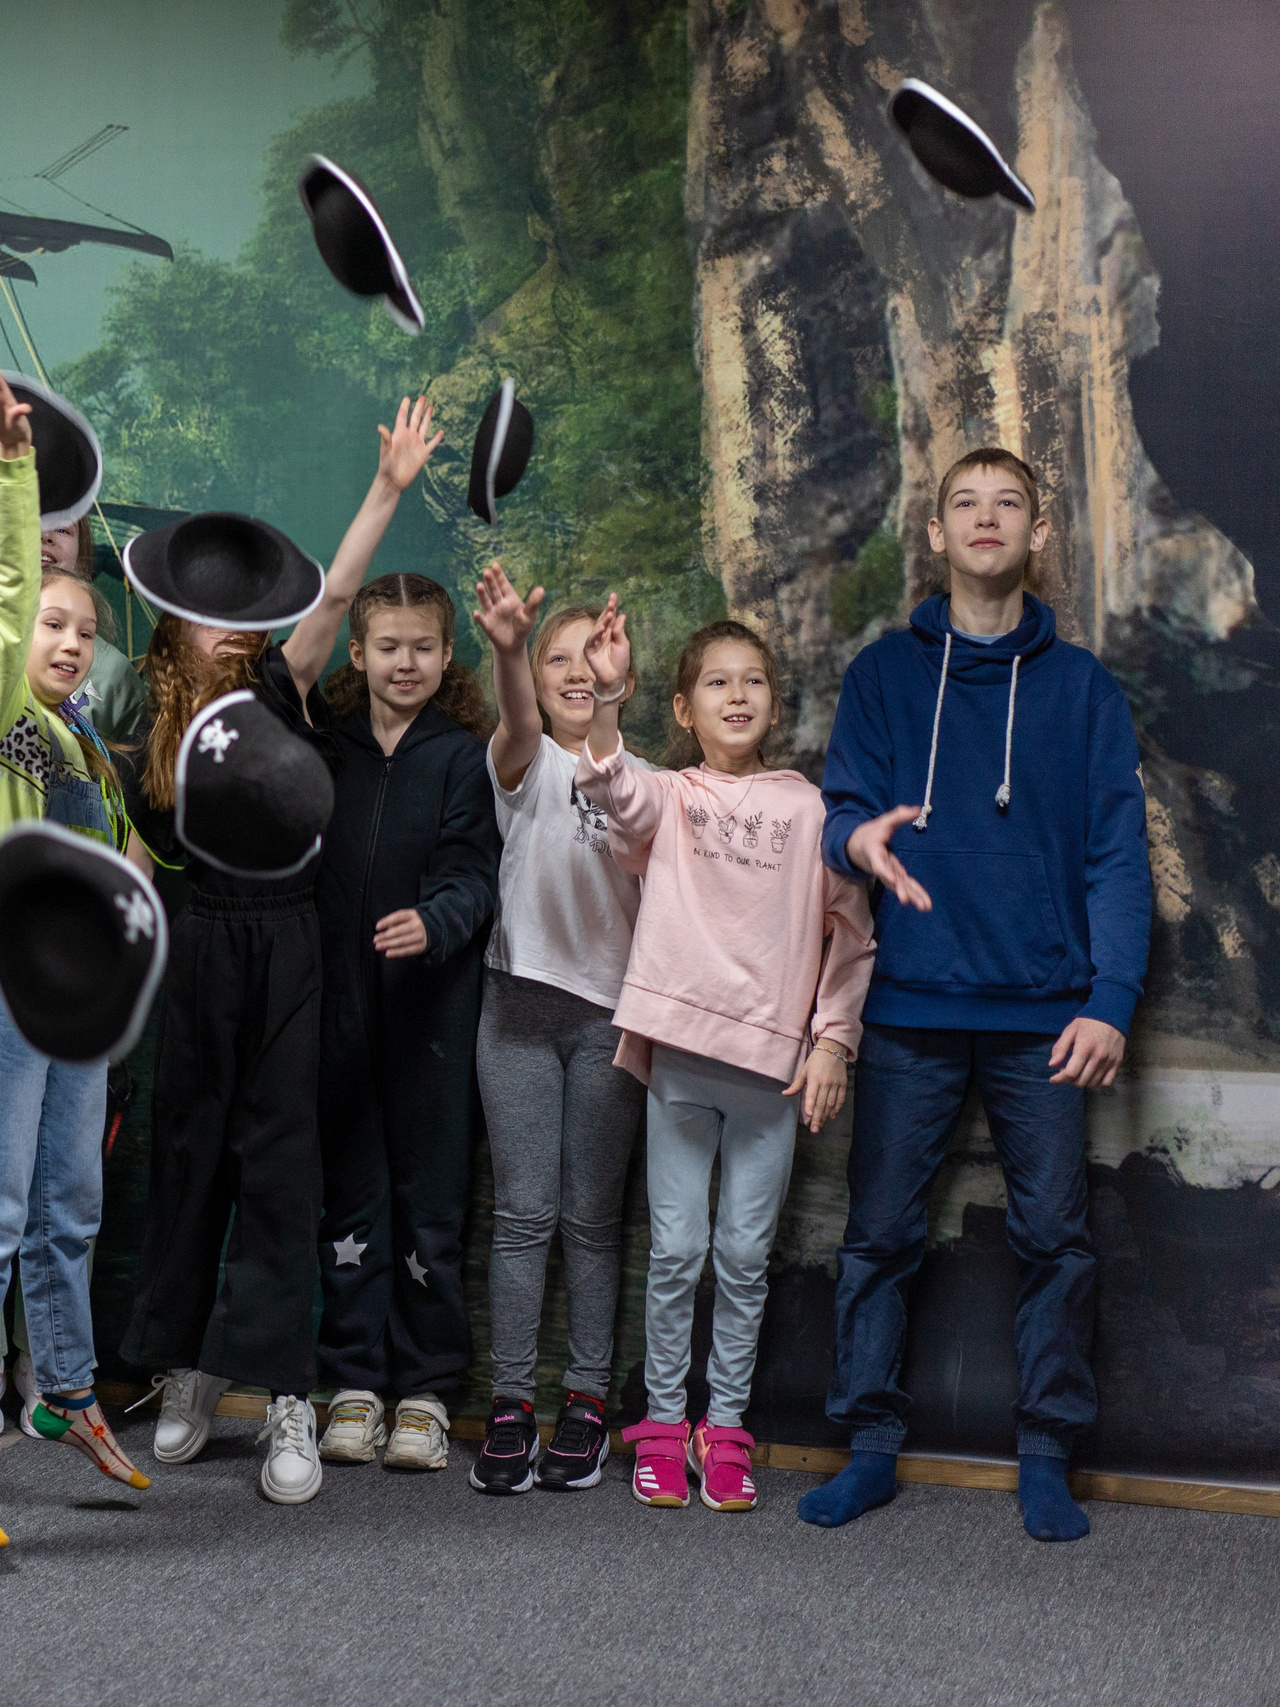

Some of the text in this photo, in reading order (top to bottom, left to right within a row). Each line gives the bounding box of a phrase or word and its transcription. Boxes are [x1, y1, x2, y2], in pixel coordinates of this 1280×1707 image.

[693, 847, 782, 872] BE KIND TO OUR PLANET
